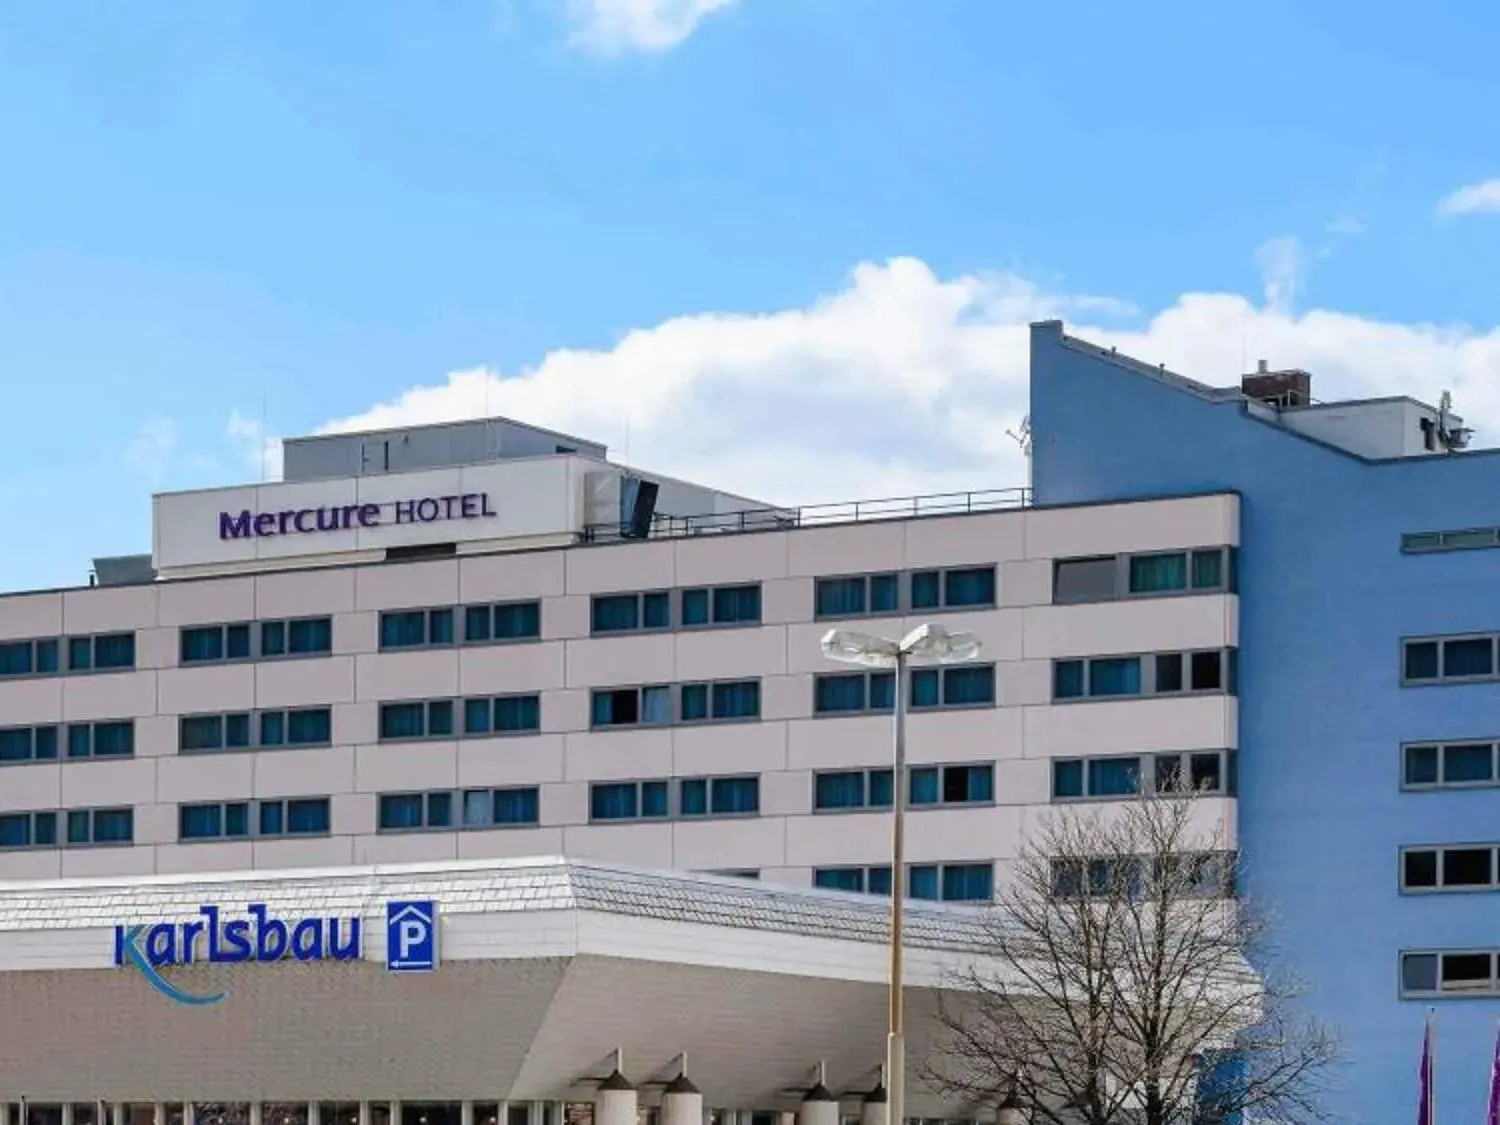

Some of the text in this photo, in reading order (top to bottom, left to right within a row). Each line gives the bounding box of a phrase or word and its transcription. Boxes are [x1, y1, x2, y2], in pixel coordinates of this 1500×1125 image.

[219, 492, 497, 541] Mercure HOTEL
[114, 903, 362, 1005] Karlsbau
[401, 921, 427, 958] P
